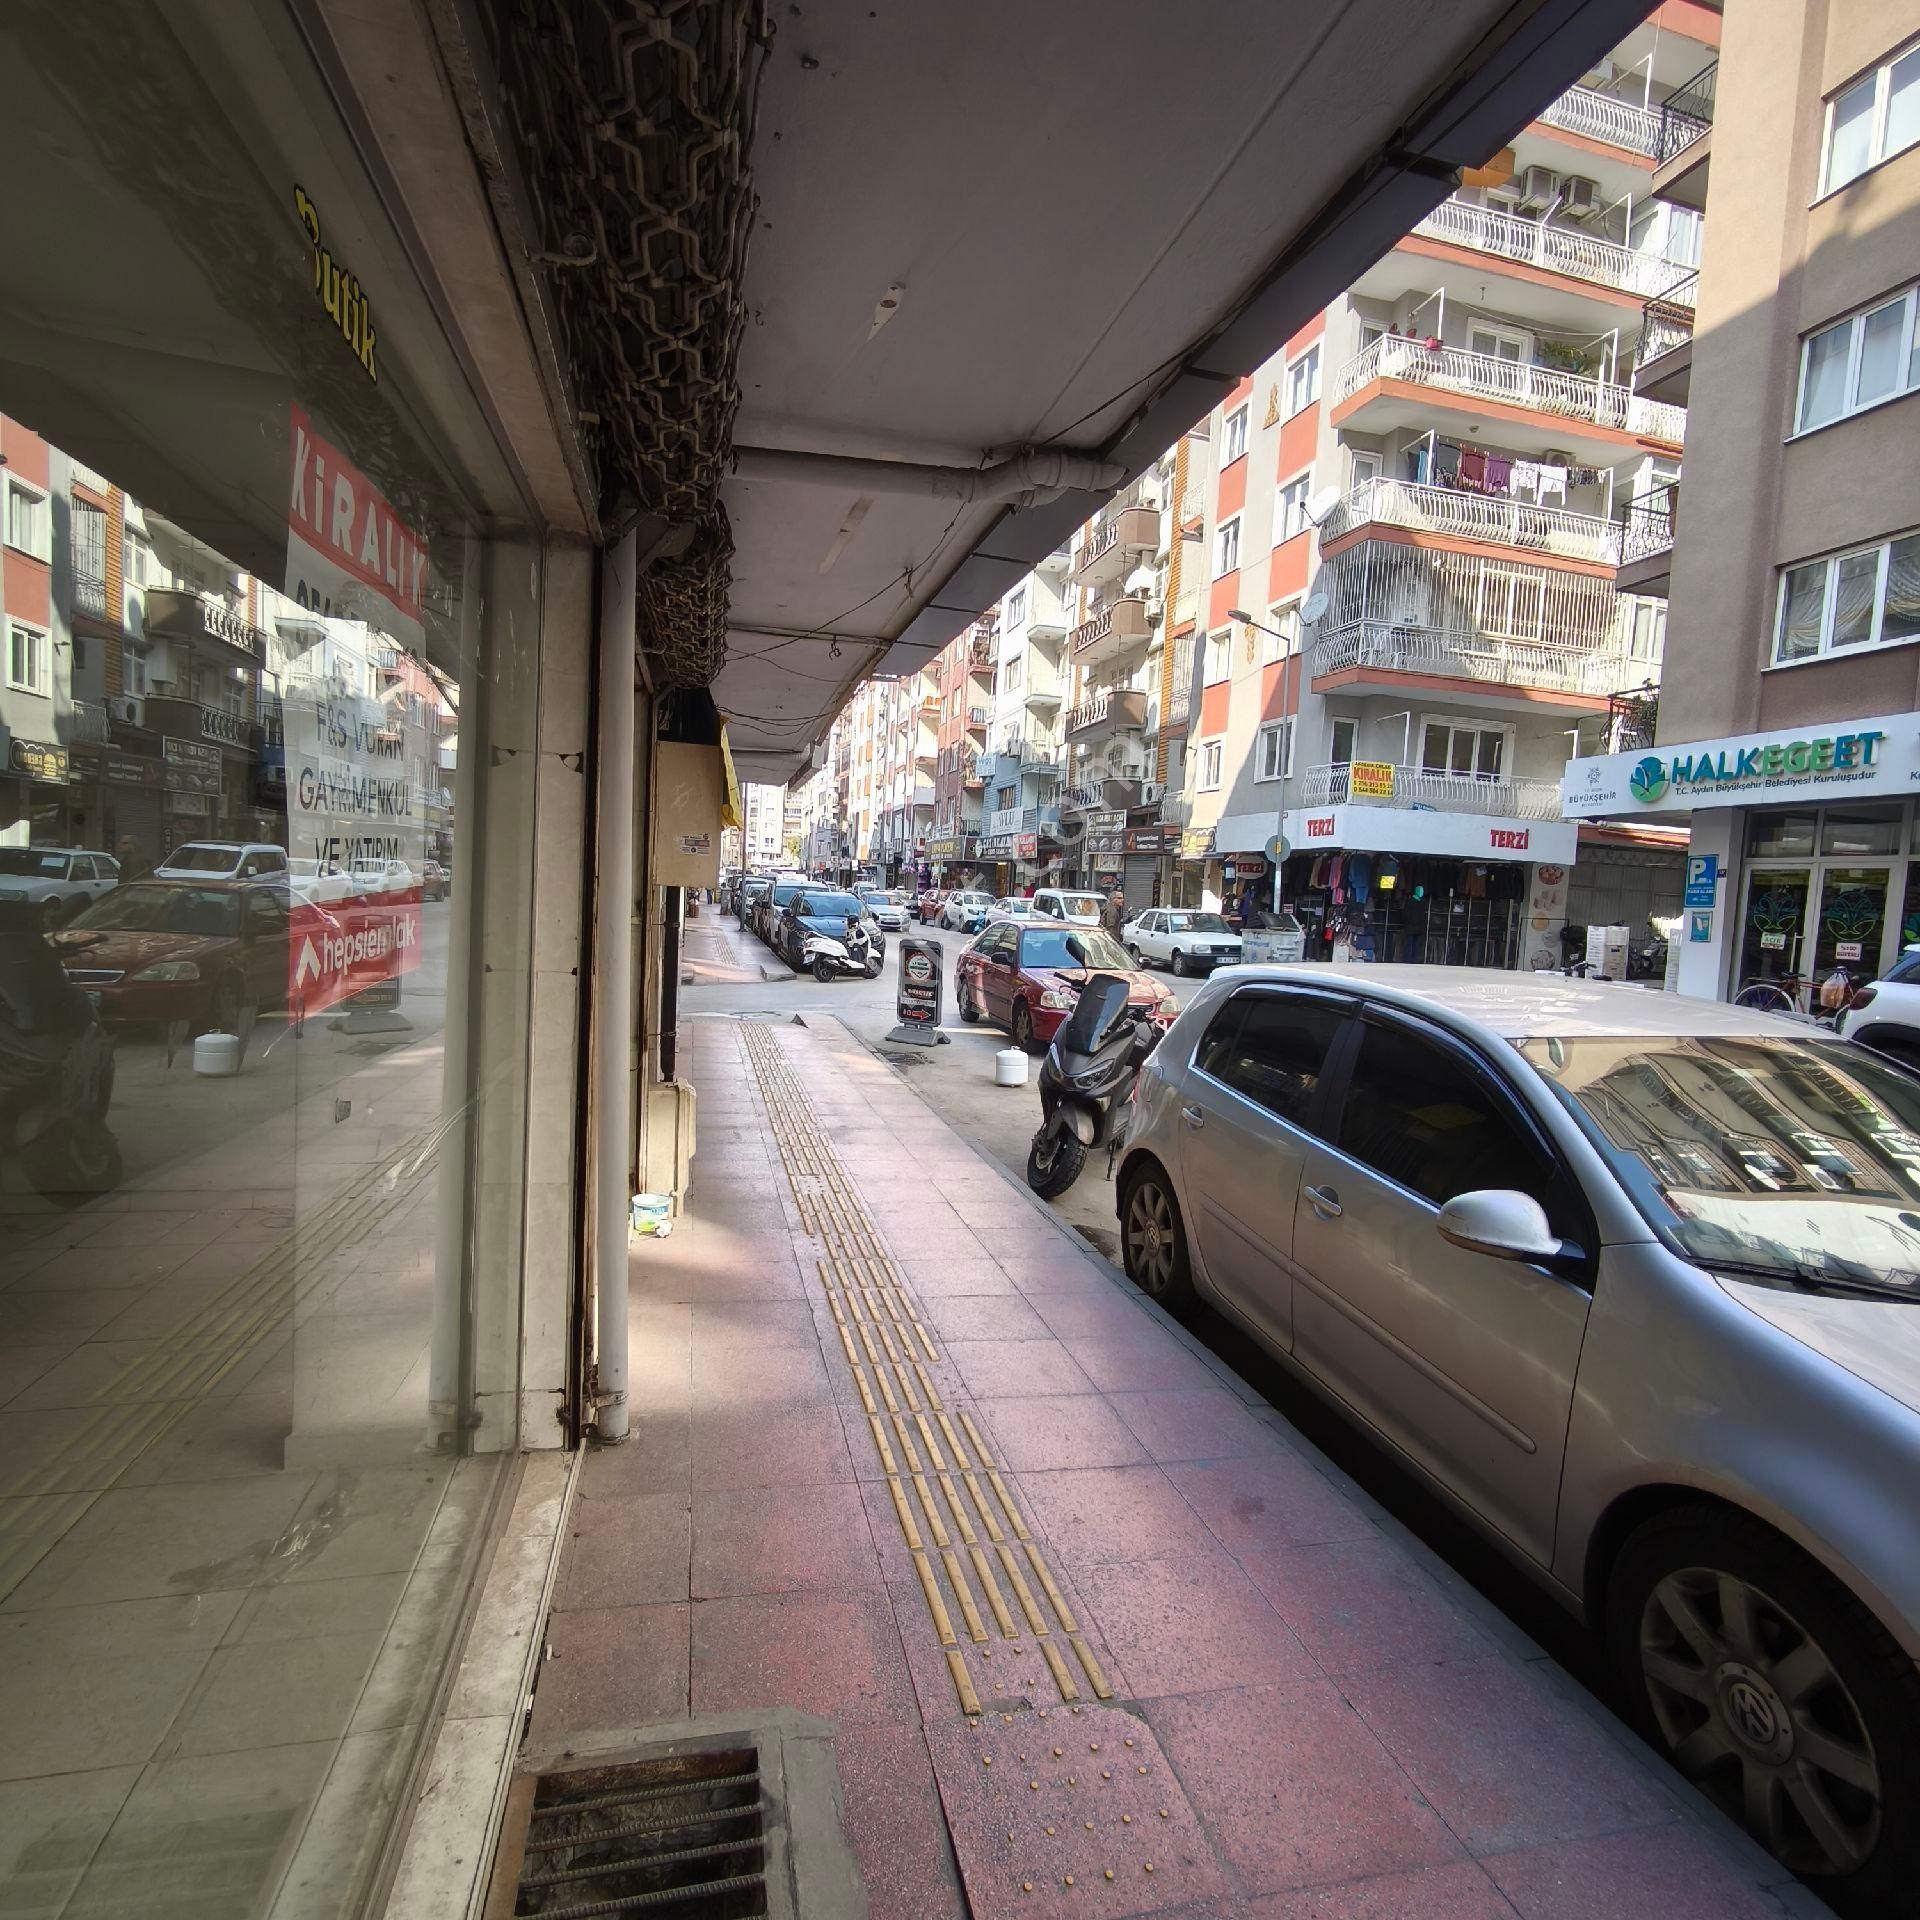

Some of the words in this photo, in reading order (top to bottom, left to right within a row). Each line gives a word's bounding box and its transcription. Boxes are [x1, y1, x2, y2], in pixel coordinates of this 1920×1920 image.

[1354, 767, 1392, 781] KIRALIK
[1675, 786, 1689, 796] T.C.
[1690, 783, 1714, 796] Aydın
[1715, 780, 1762, 793] Büyükşehir
[1764, 775, 1812, 788] Belediyesi
[1813, 769, 1877, 784] Kuruluşudur
[1569, 791, 1617, 804] BÜYÜKŞEHİR
[1307, 813, 1336, 837] TERZİ
[1490, 828, 1529, 850] TERZİ
[322, 912, 416, 976] hepsiemlak
